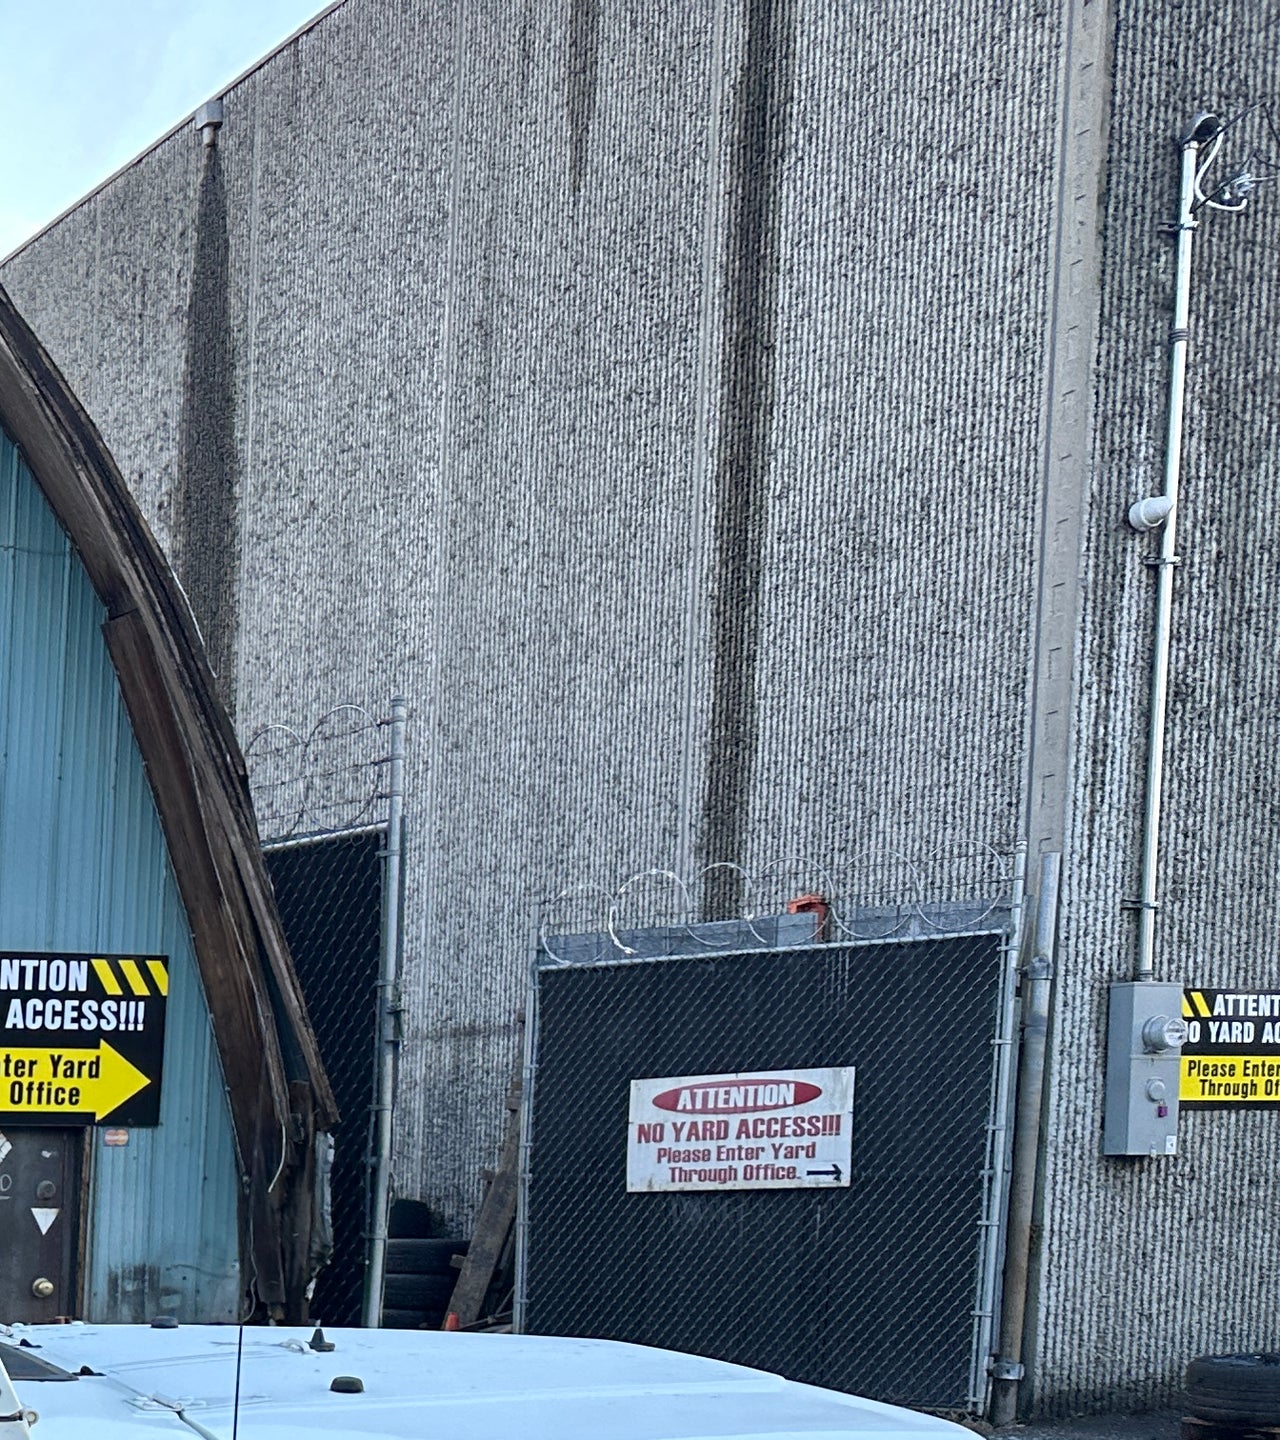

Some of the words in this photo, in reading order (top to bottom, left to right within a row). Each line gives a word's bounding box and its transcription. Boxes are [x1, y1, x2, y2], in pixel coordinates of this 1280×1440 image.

[5, 999, 145, 1032] ACCESS!!!
[1209, 1021, 1255, 1043] YARD
[50, 1055, 101, 1079] Yard
[1188, 1060, 1236, 1077] Please
[1243, 1060, 1280, 1077] Enter
[10, 1082, 80, 1106] Office
[676, 1083, 796, 1111] ATTENTION
[1199, 1079, 1257, 1099] Through
[637, 1123, 665, 1143] NO
[671, 1119, 729, 1142] YARD
[736, 1115, 841, 1140] ACCESS!!!
[657, 1147, 711, 1164] Please
[716, 1145, 765, 1161] Enter
[771, 1142, 816, 1160] Yard
[669, 1165, 737, 1185] Through
